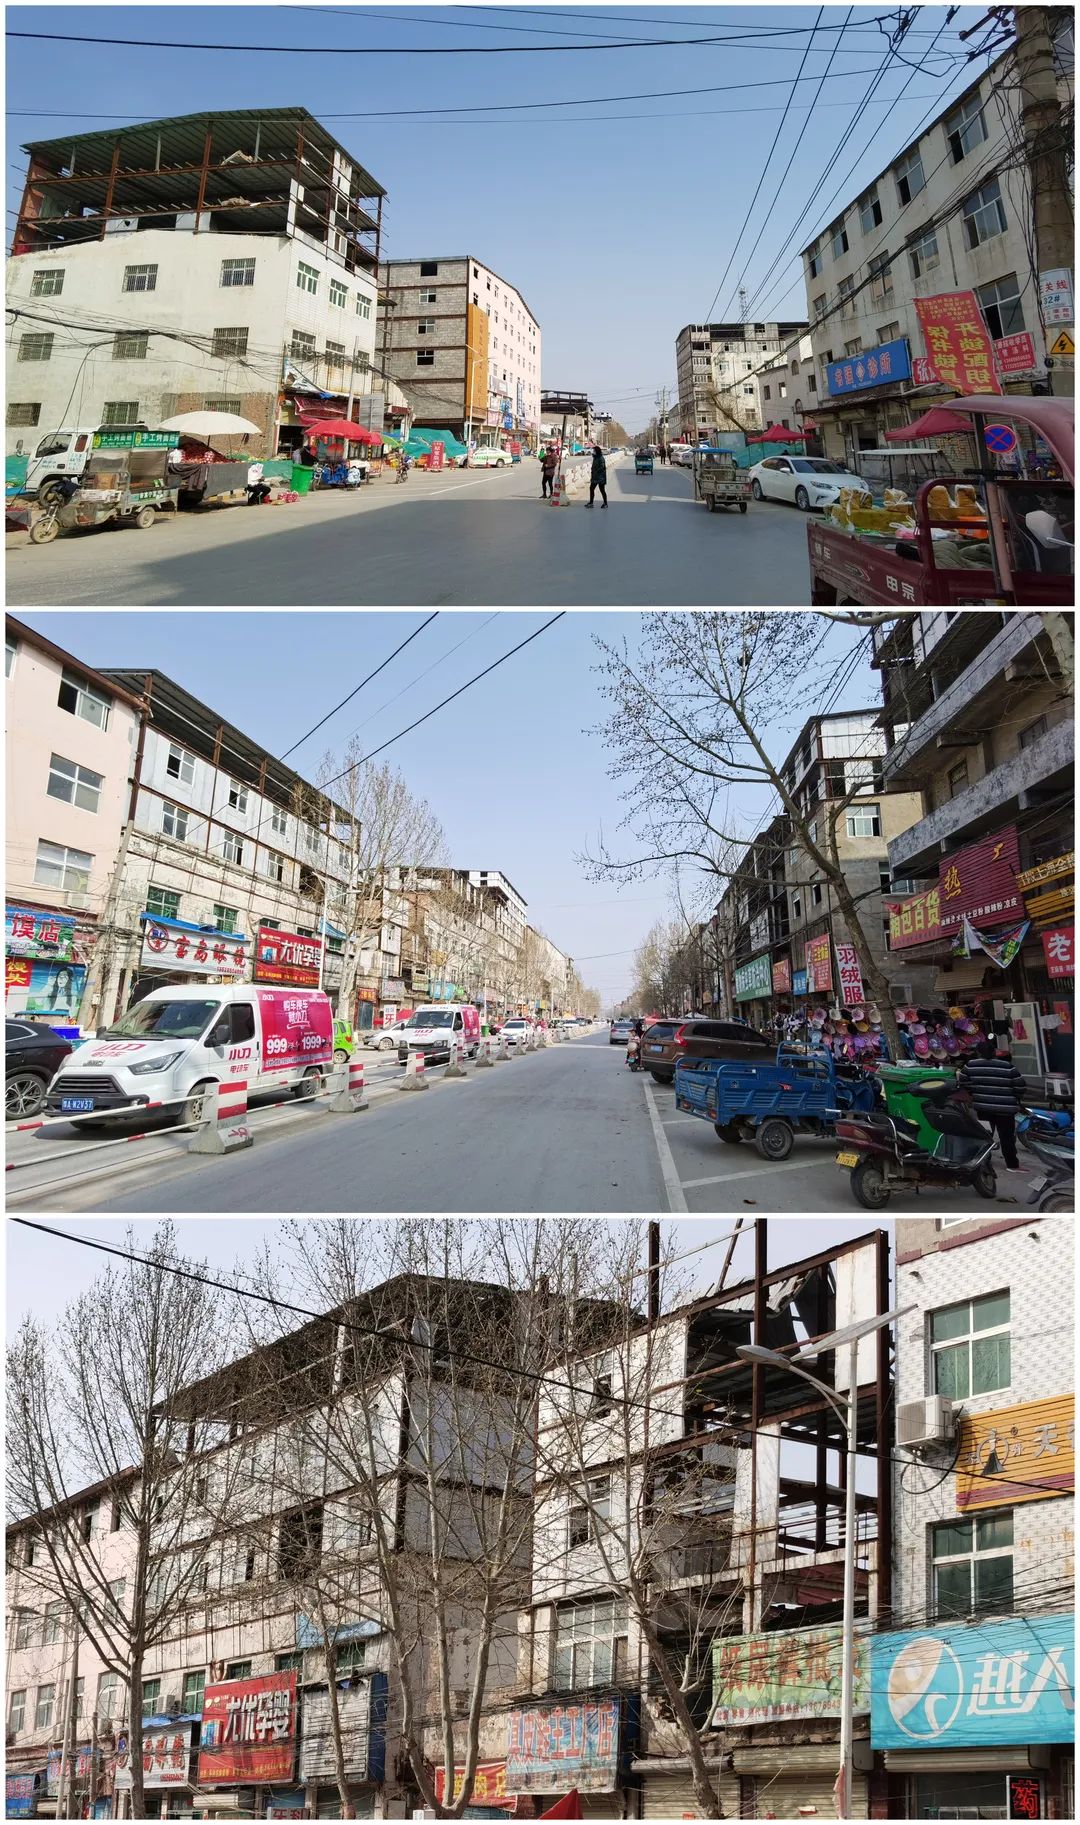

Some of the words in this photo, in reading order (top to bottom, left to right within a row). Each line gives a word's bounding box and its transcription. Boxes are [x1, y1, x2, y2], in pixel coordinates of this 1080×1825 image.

[6, 912, 62, 943] 馍店
[1048, 932, 1072, 962] 老
[837, 947, 865, 1004] 羽绒服
[266, 1037, 288, 1055] 999
[301, 1035, 322, 1050] 1999
[1033, 1421, 1075, 1459] 天
[223, 1688, 290, 1742] 尤优孕婴
